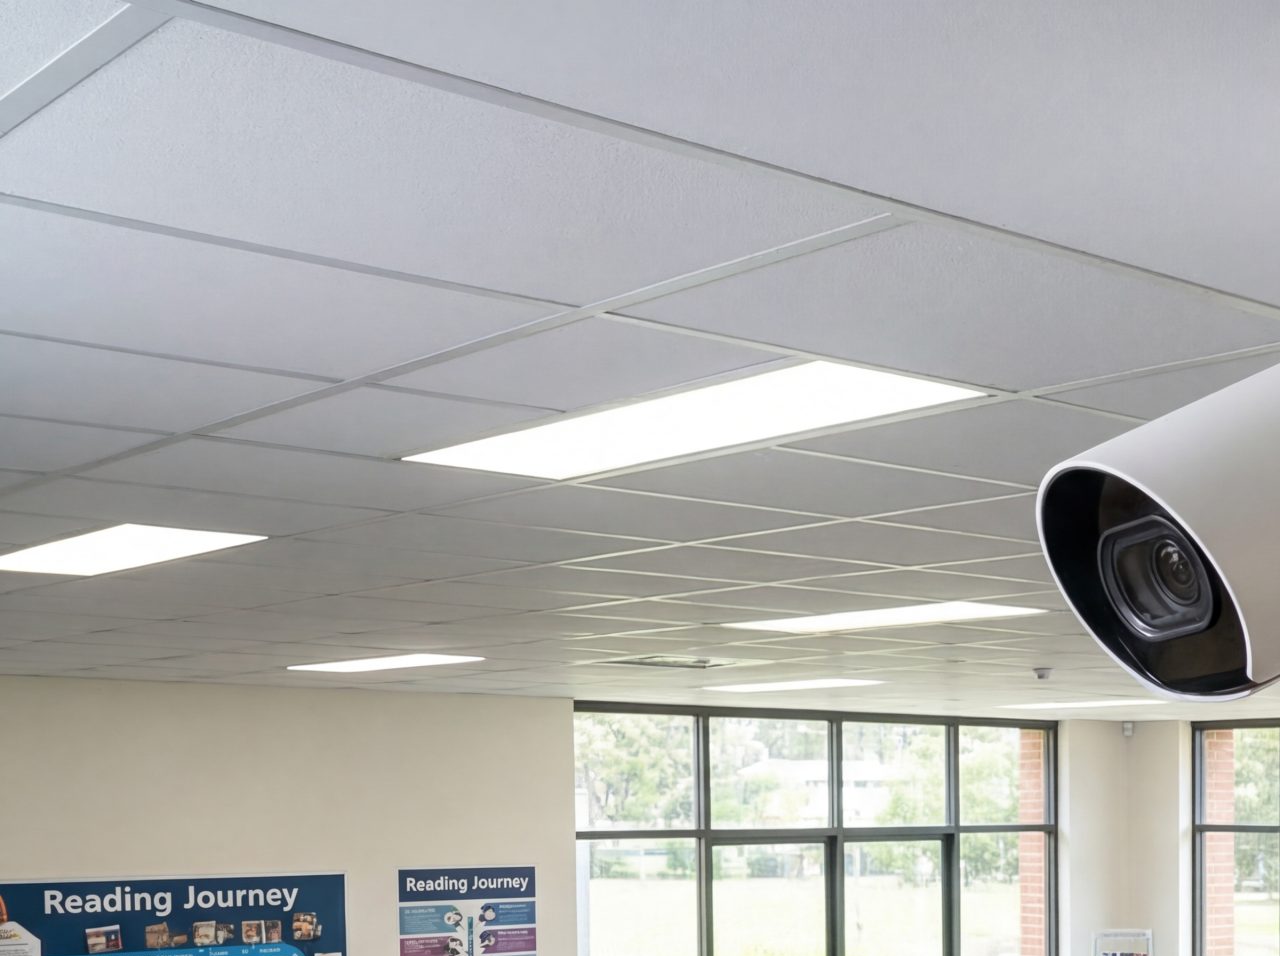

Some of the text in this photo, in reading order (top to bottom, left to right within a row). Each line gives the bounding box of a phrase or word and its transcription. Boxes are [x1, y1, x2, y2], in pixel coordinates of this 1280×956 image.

[406, 875, 529, 894] Reading Journey
[43, 885, 299, 916] Reading Journey
